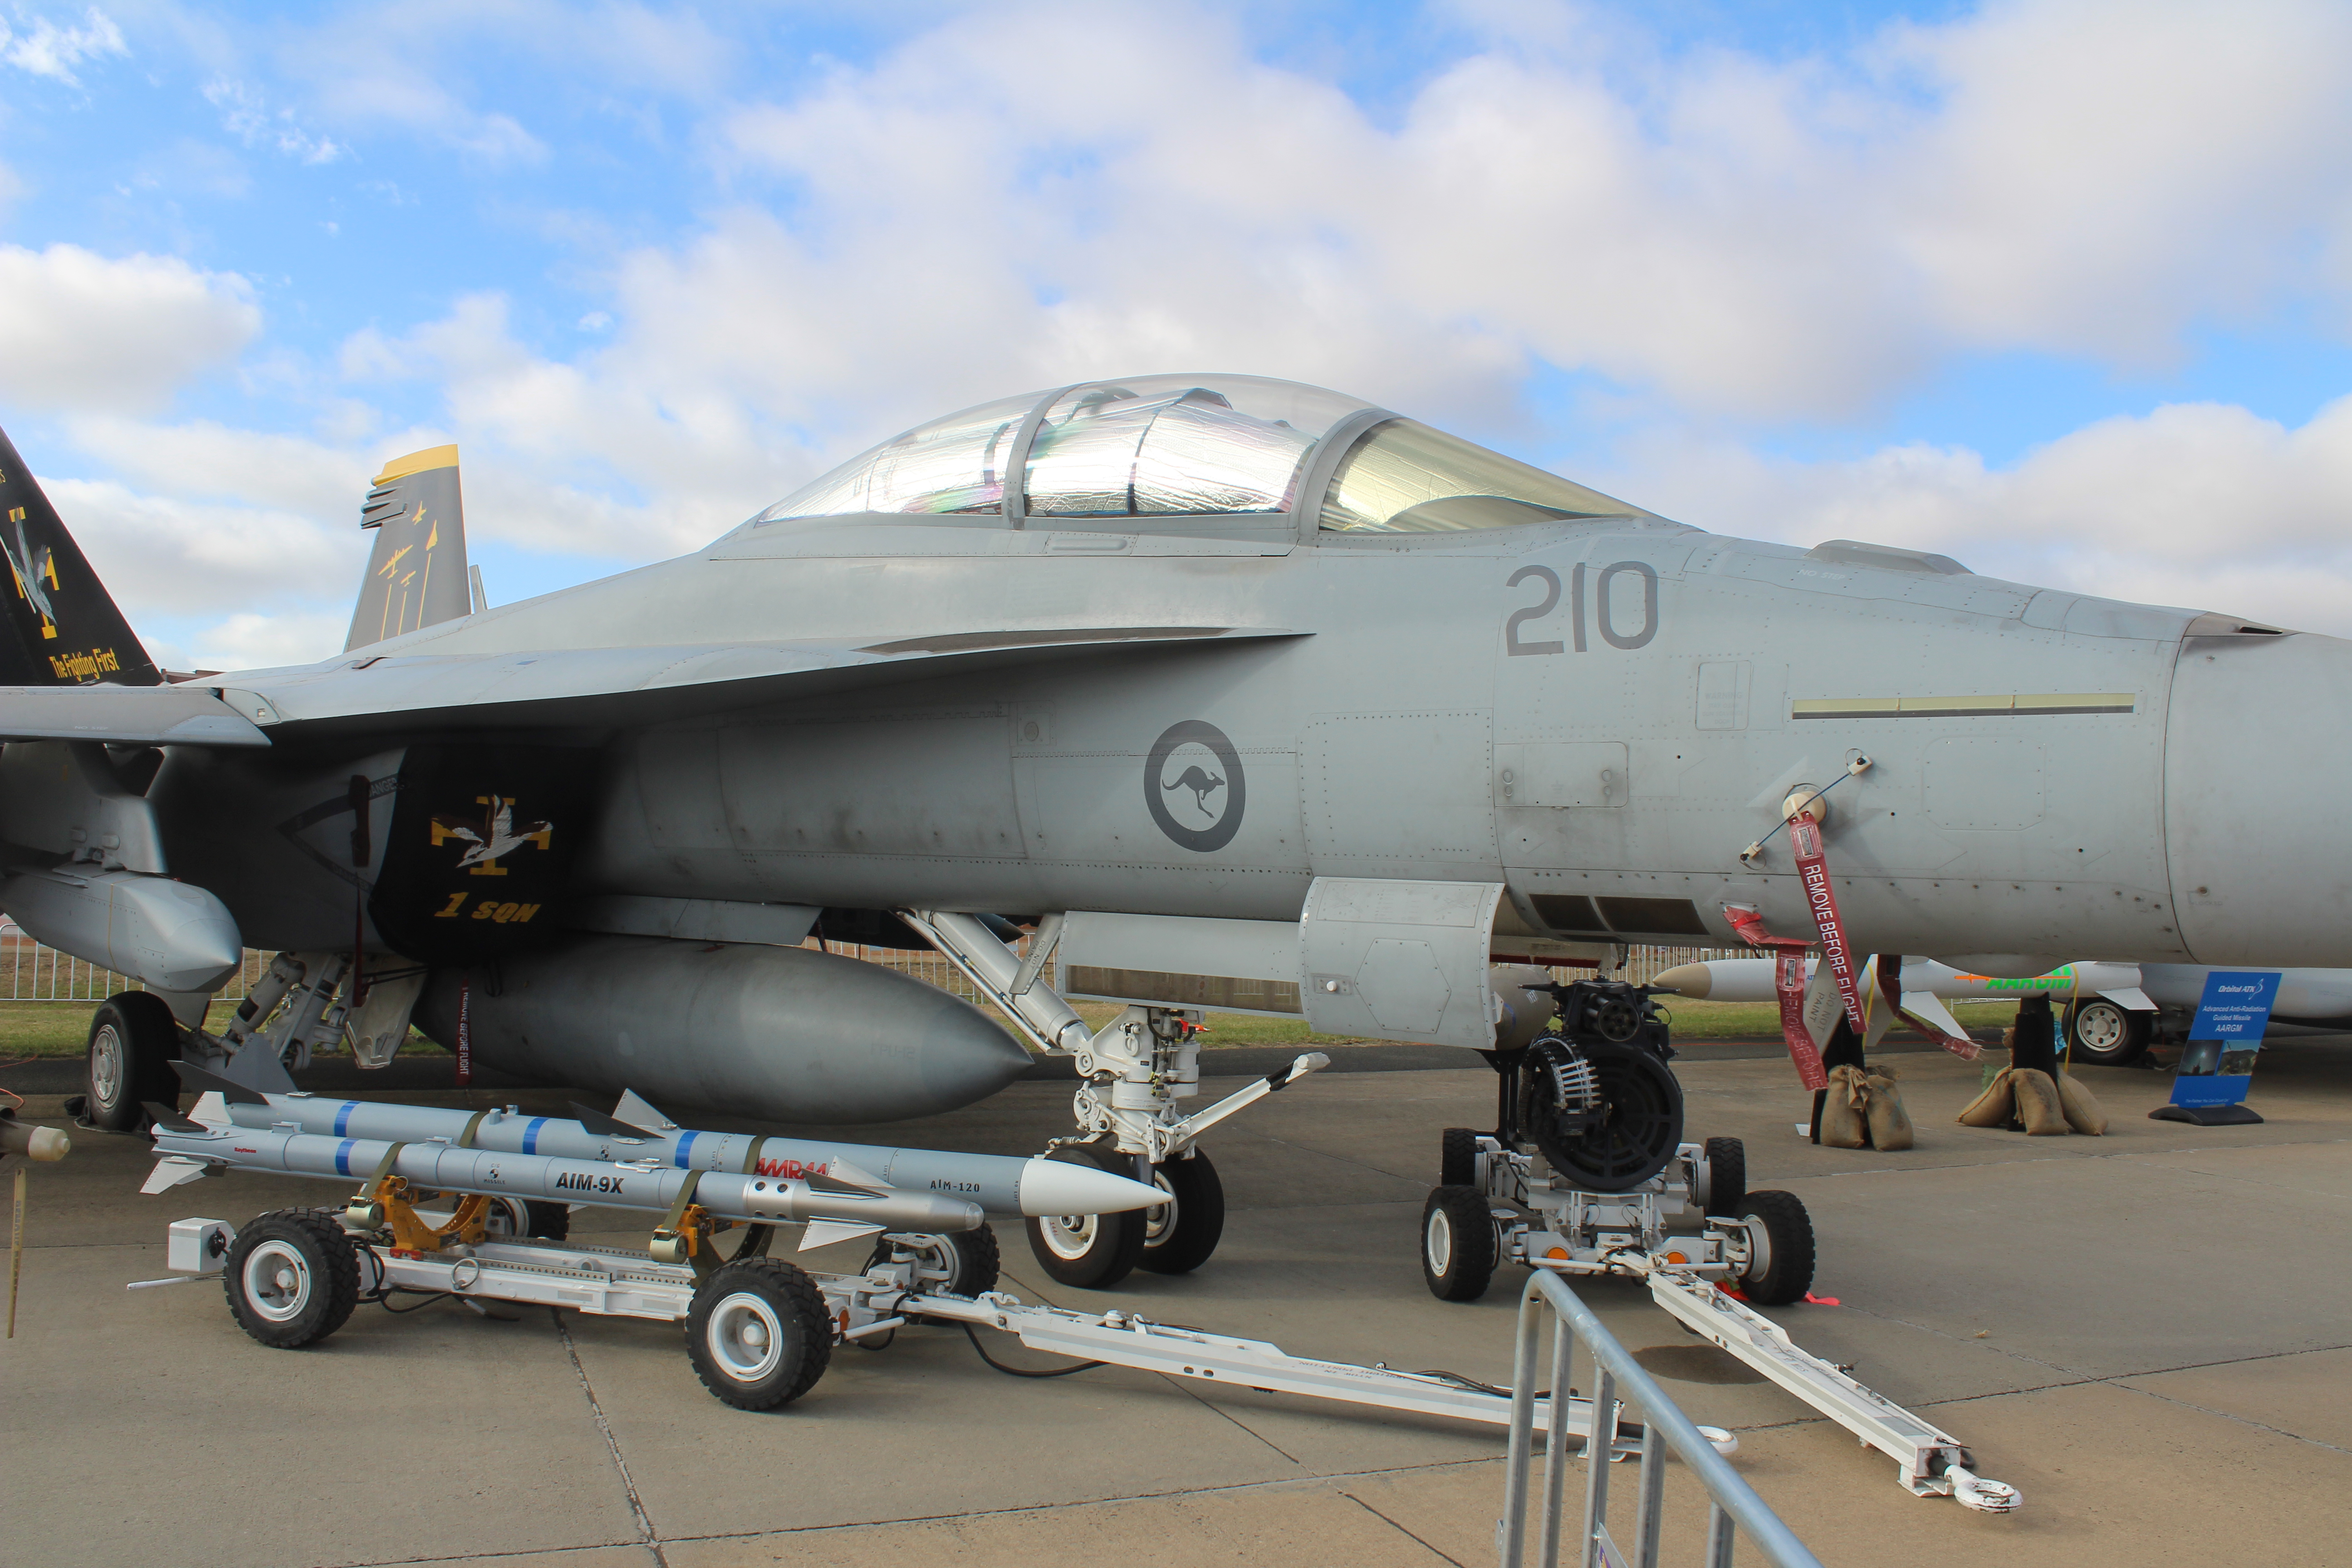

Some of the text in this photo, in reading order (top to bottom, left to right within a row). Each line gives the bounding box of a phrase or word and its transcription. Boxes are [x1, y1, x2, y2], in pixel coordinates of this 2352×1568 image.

[1505, 560, 1659, 657] 210
[48, 647, 120, 681] The Fighting First
[434, 892, 541, 924] 1 SQN
[1804, 864, 1833, 921] REMOVE
[1819, 921, 1847, 974] BEFORE
[1027, 941, 1038, 963] PAINT
[1029, 940, 1045, 969] DO NOT
[1809, 992, 1825, 1022] PAINT
[1818, 993, 1837, 1032] DO NOT
[459, 992, 469, 1075] REMOVE BEFORE FLIGHT
[556, 1172, 625, 1194] AIM-9X
[931, 1179, 980, 1192] AIM-120
